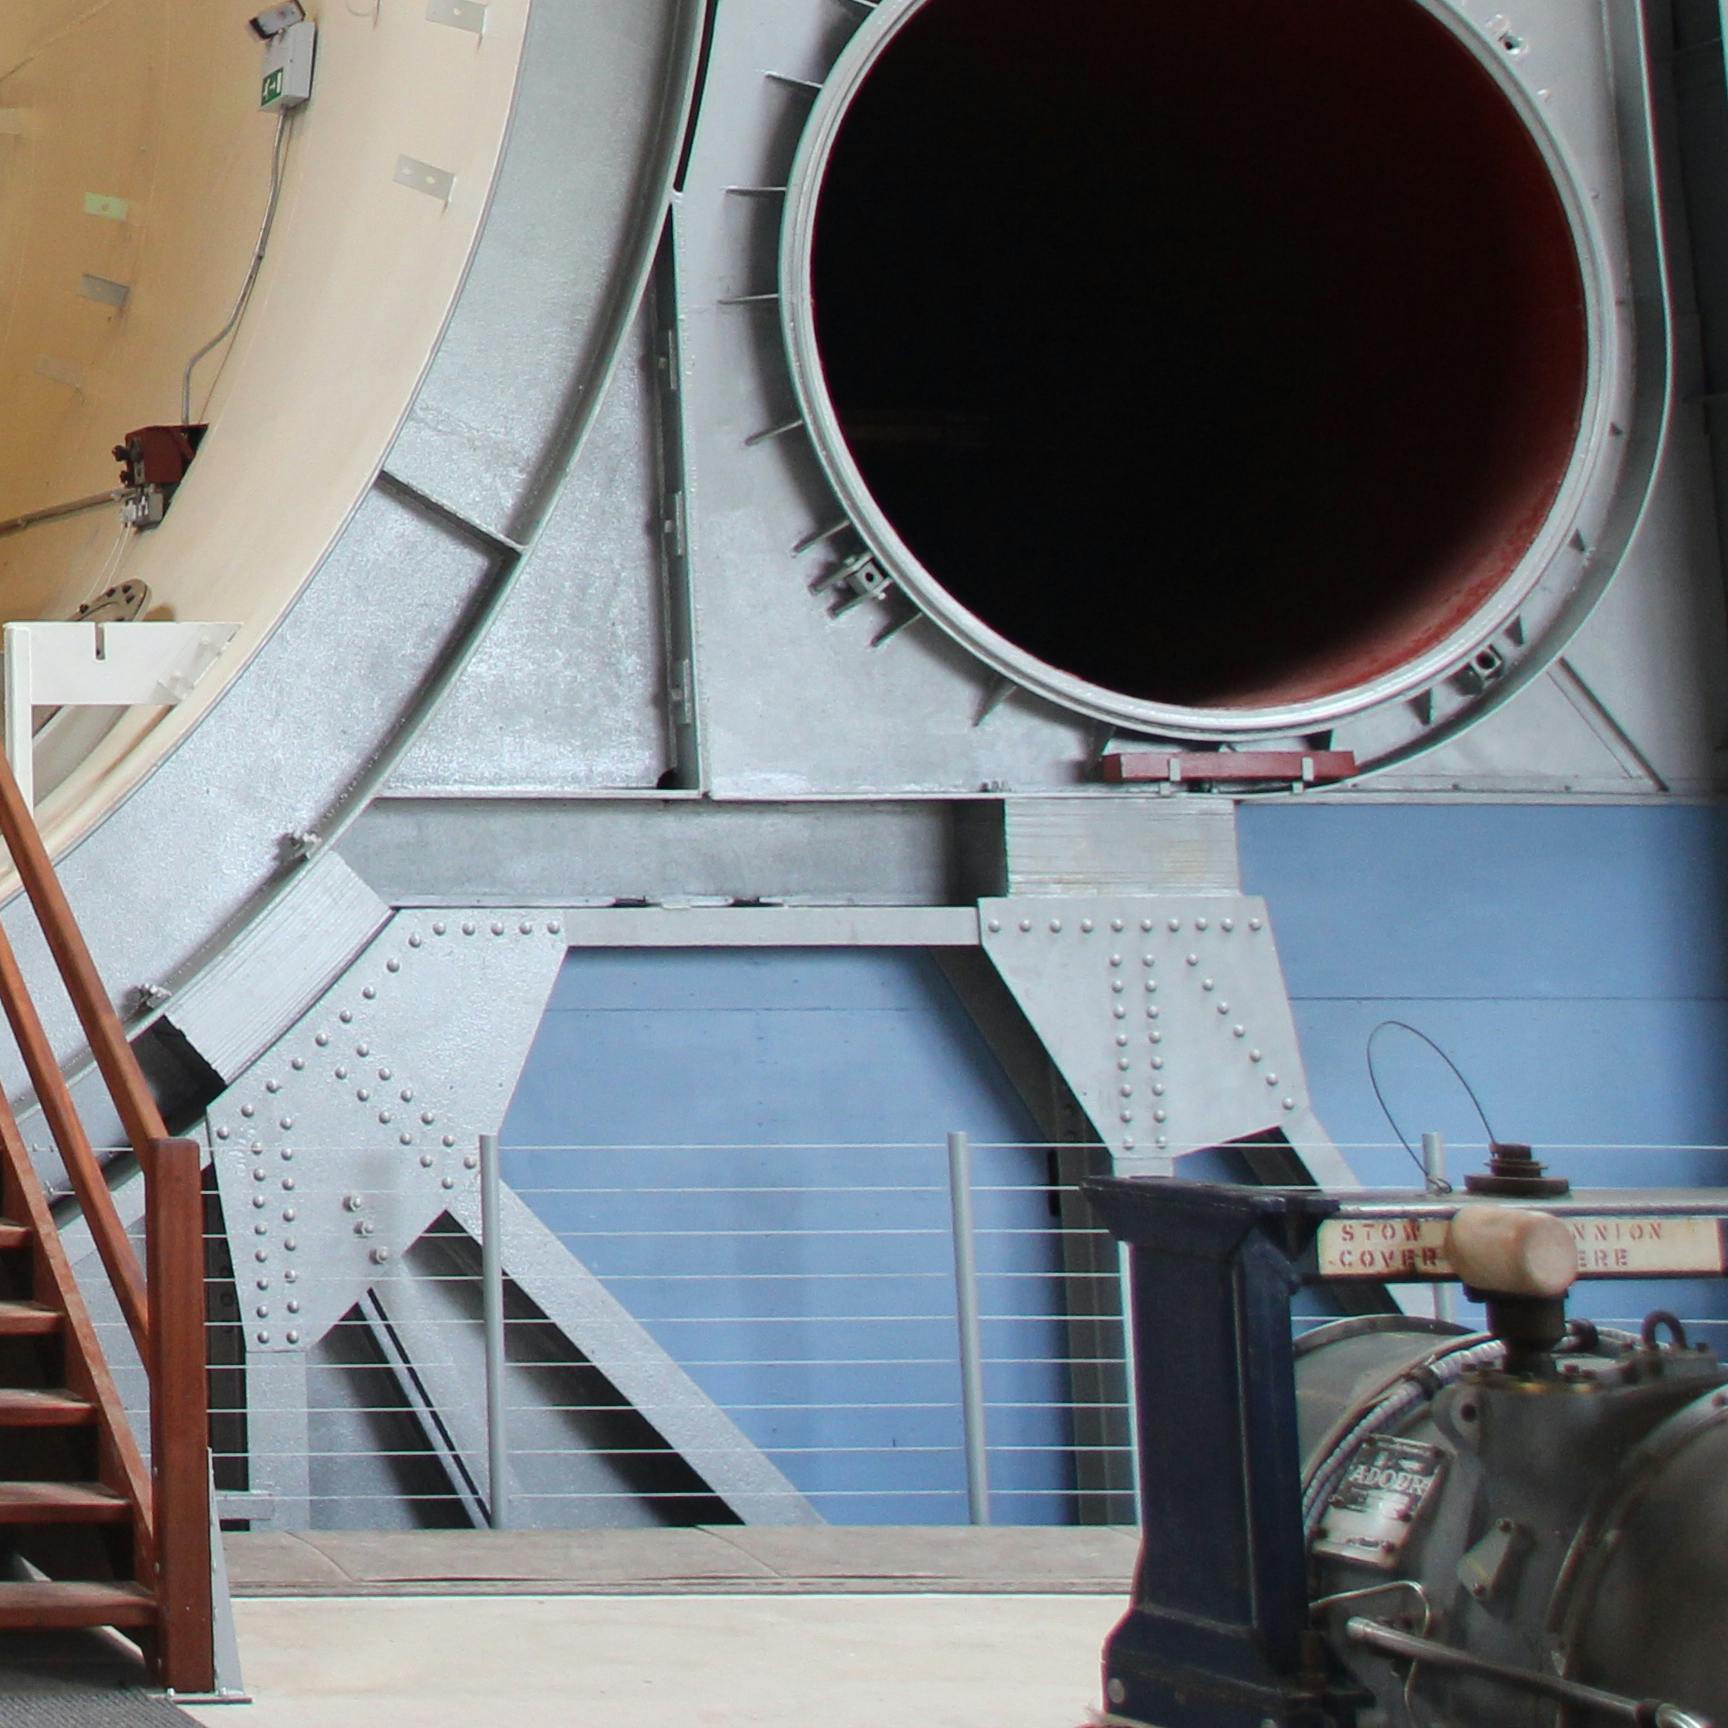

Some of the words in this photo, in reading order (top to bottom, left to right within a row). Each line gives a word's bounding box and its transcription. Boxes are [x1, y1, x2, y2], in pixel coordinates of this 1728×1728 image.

[1341, 1224, 1420, 1241] STOW
[1572, 1223, 1662, 1240] NNION
[1339, 1248, 1437, 1268] COVER
[1577, 1248, 1628, 1267] ERE
